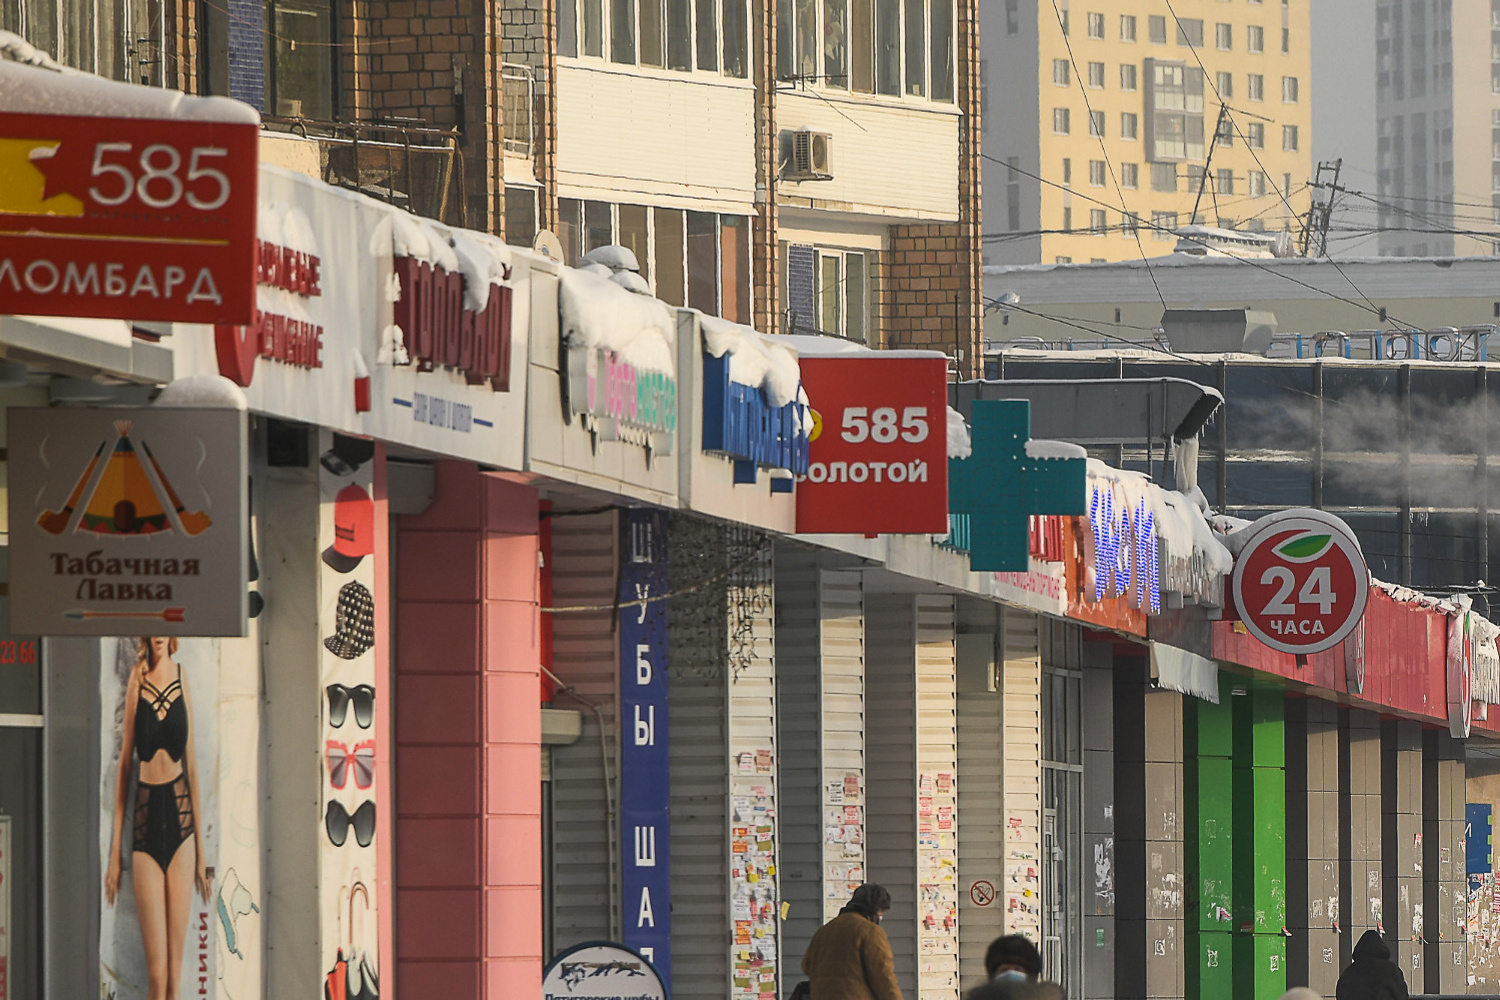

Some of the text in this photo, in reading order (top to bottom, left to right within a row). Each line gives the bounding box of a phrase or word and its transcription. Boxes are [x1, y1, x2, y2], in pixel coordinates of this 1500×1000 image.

[88, 142, 231, 211] 585
[841, 407, 929, 444] 585
[795, 459, 928, 483] ОЛОТОЙ
[50, 549, 200, 576] Табачная
[75, 577, 173, 600] Лавка
[1259, 565, 1337, 615] 24
[1270, 619, 1325, 634] ЧАСА
